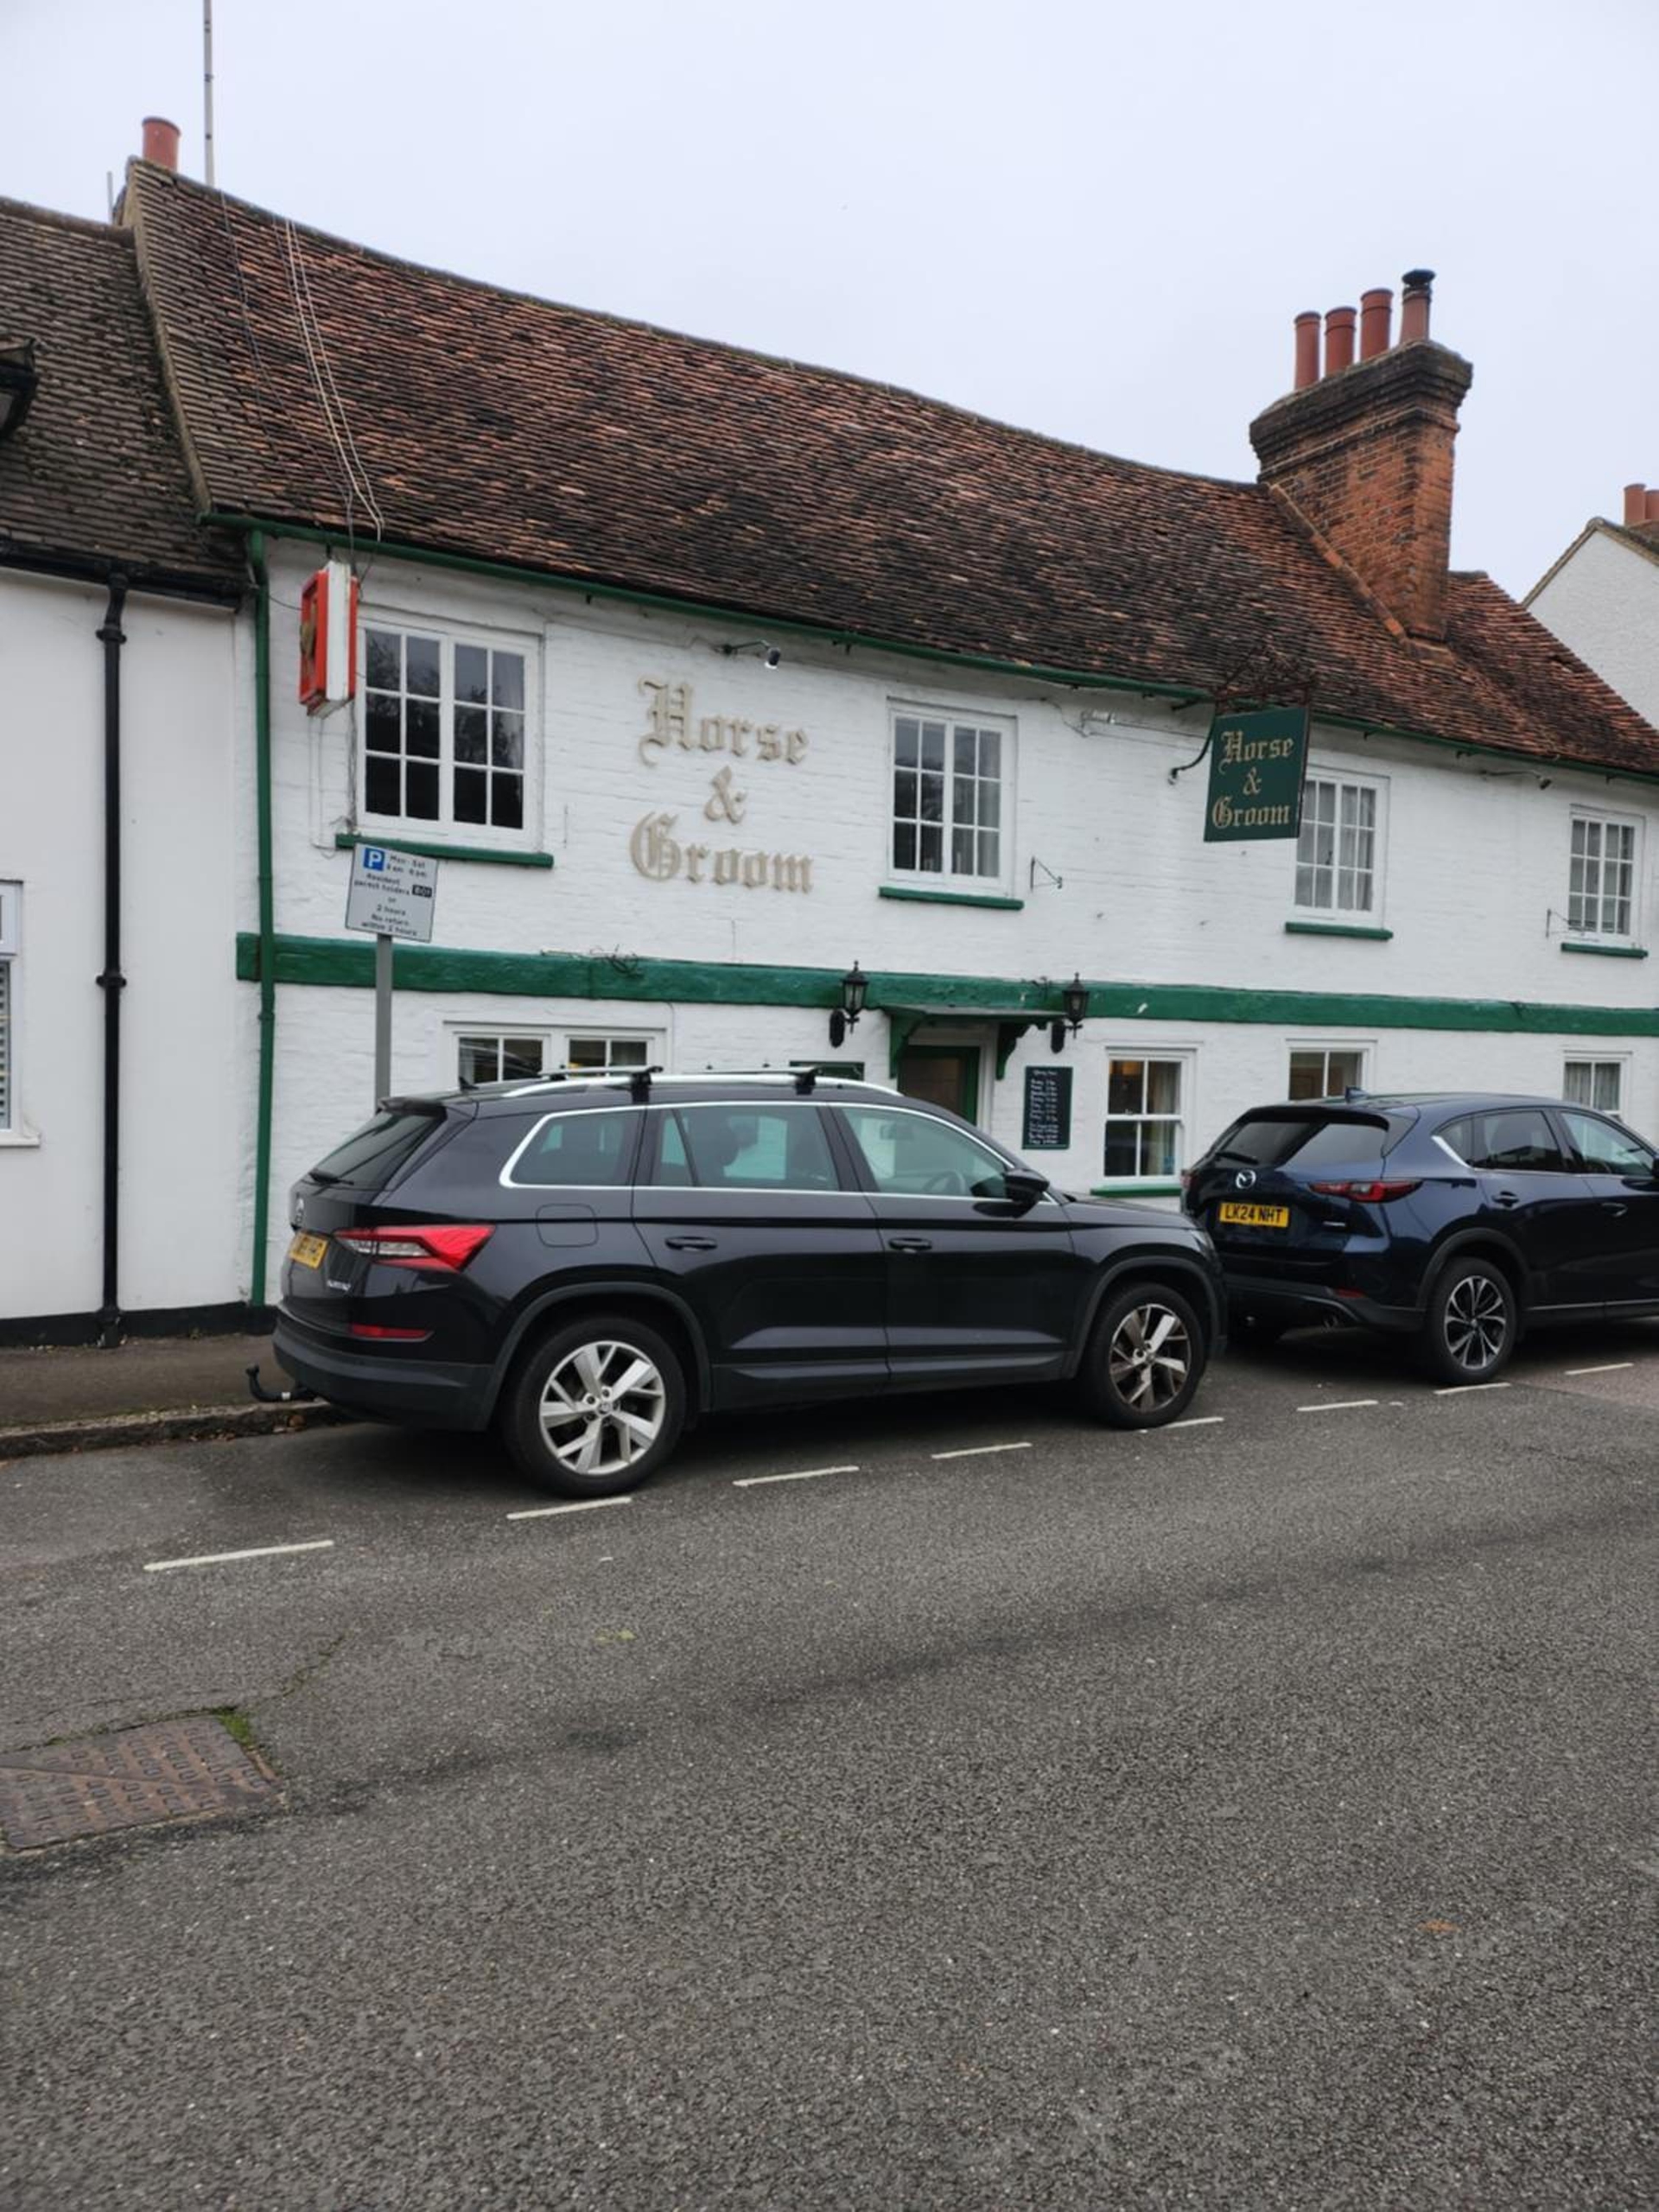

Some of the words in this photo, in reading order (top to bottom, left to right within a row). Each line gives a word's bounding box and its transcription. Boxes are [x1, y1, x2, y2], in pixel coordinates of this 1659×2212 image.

[638, 673, 809, 768] Horse
[1218, 731, 1294, 774] Horse
[704, 766, 747, 825] &
[1243, 766, 1262, 795] &
[1212, 795, 1290, 829] Groom
[368, 849, 382, 868] P
[630, 811, 813, 893] Groom
[385, 905, 406, 916] hours
[395, 925, 417, 936] hours
[1224, 1205, 1255, 1222] LK24
[1258, 1207, 1284, 1224] NHT
